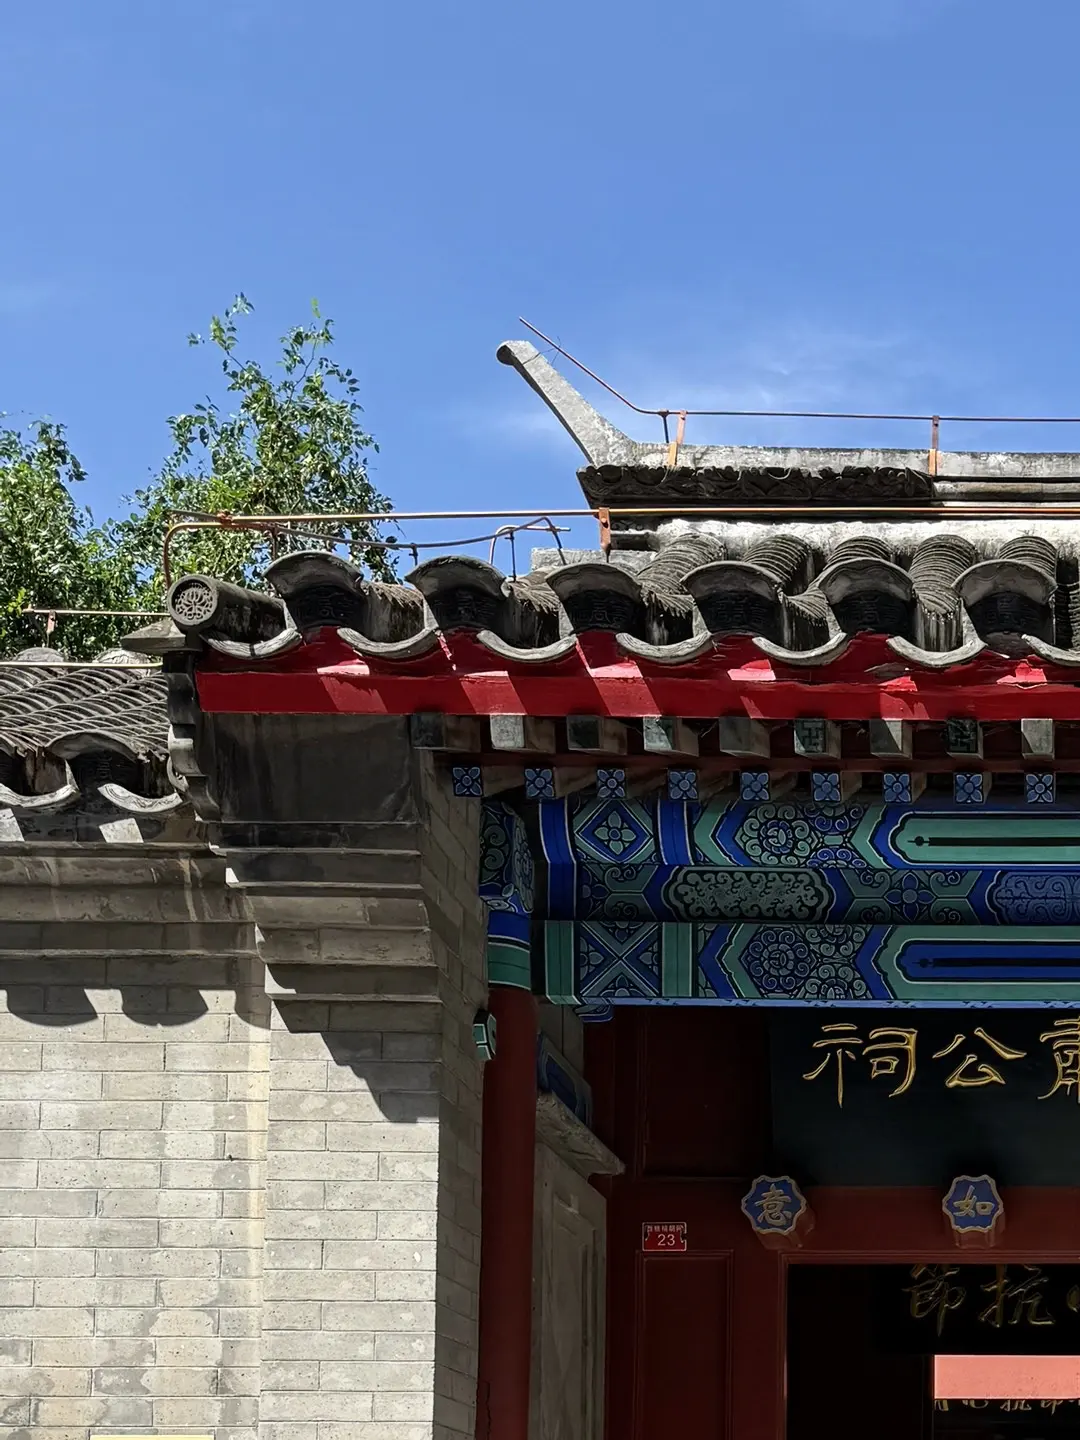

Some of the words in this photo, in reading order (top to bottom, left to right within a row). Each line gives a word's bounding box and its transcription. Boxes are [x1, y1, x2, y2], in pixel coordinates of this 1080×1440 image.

[753, 1182, 793, 1227] 意
[952, 1184, 994, 1218] 如
[657, 1233, 676, 1246] 23
